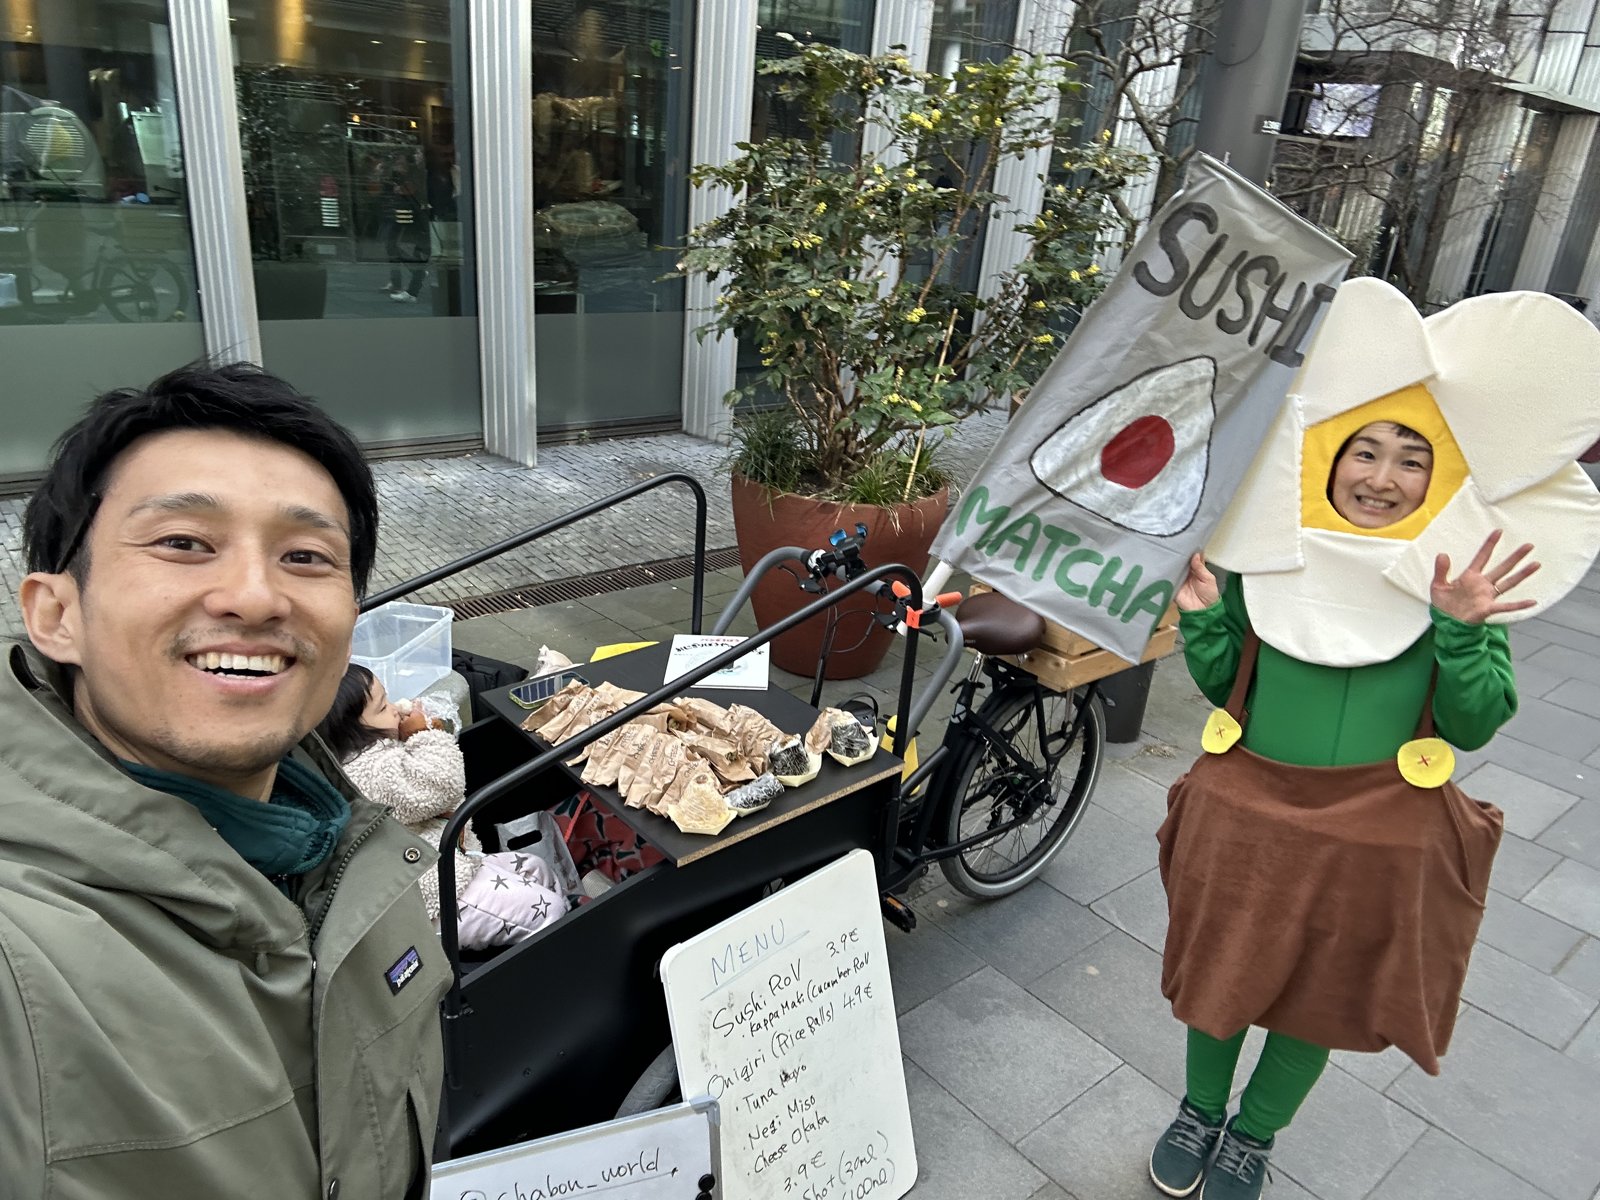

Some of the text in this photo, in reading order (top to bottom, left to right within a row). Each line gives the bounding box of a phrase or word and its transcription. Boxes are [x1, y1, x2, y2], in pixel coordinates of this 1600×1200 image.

[1132, 201, 1337, 368] SUSHI
[955, 486, 1179, 640] MATCHA
[711, 918, 785, 986] MENU
[712, 928, 859, 1038] Sushi Roll 3.9€
[842, 982, 873, 1009] 4.9€
[742, 1087, 779, 1114] Tuna
[787, 1095, 816, 1119] Miso
[754, 1110, 830, 1174] Cheese Okaka
[841, 1158, 896, 1200] 100ml)
